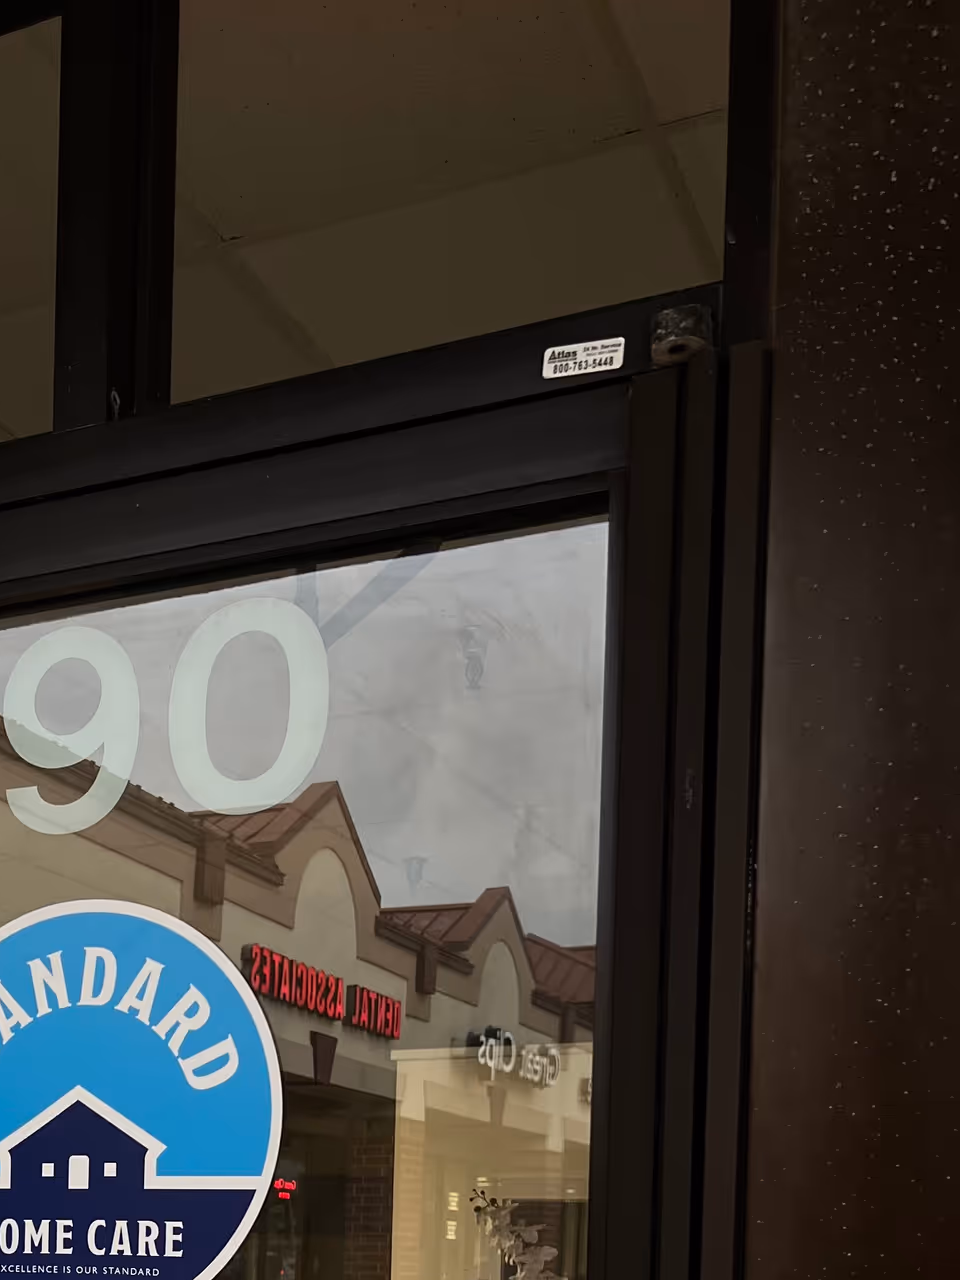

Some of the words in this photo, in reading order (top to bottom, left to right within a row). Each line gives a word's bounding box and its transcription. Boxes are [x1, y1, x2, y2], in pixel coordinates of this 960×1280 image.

[548, 350, 577, 361] Atlas
[553, 356, 614, 374] 800-763-5448
[87, 1219, 184, 1257] CARE
[62, 1265, 72, 1274] IS
[76, 1266, 98, 1275] OUR
[102, 1267, 160, 1277] STANDARD
